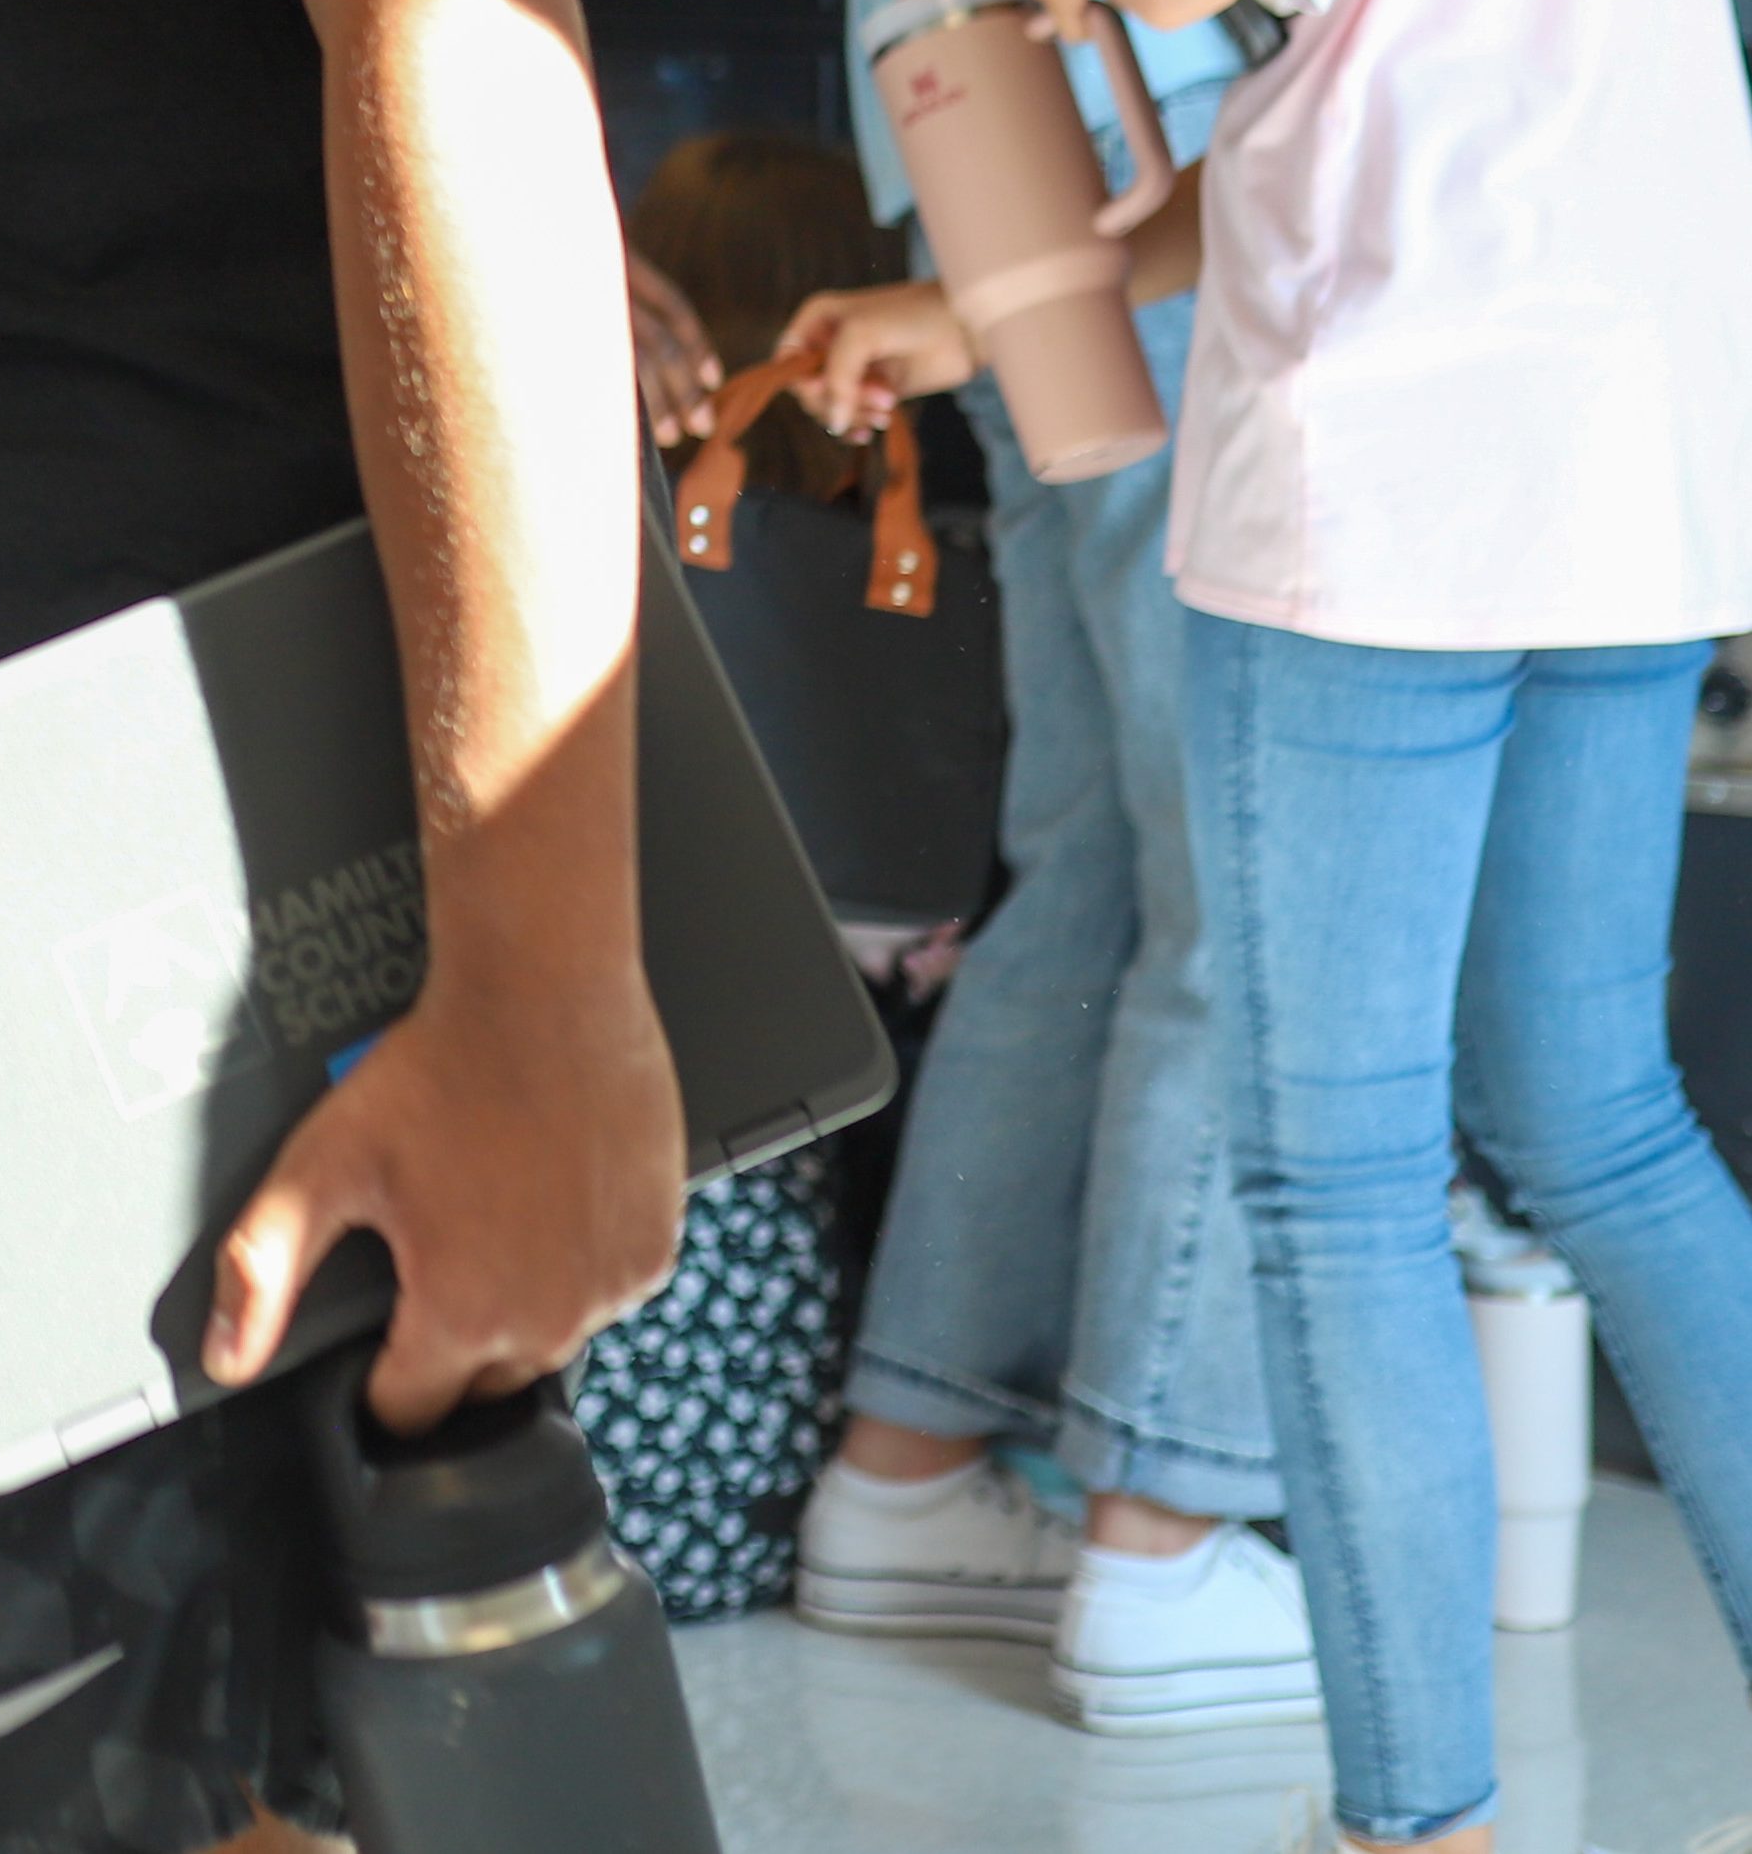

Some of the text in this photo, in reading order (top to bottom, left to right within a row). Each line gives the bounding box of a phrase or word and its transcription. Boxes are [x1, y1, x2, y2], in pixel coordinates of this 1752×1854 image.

[228, 841, 420, 944] HAMILT
[259, 893, 423, 994] COUN
[275, 946, 421, 1045] SCHO
